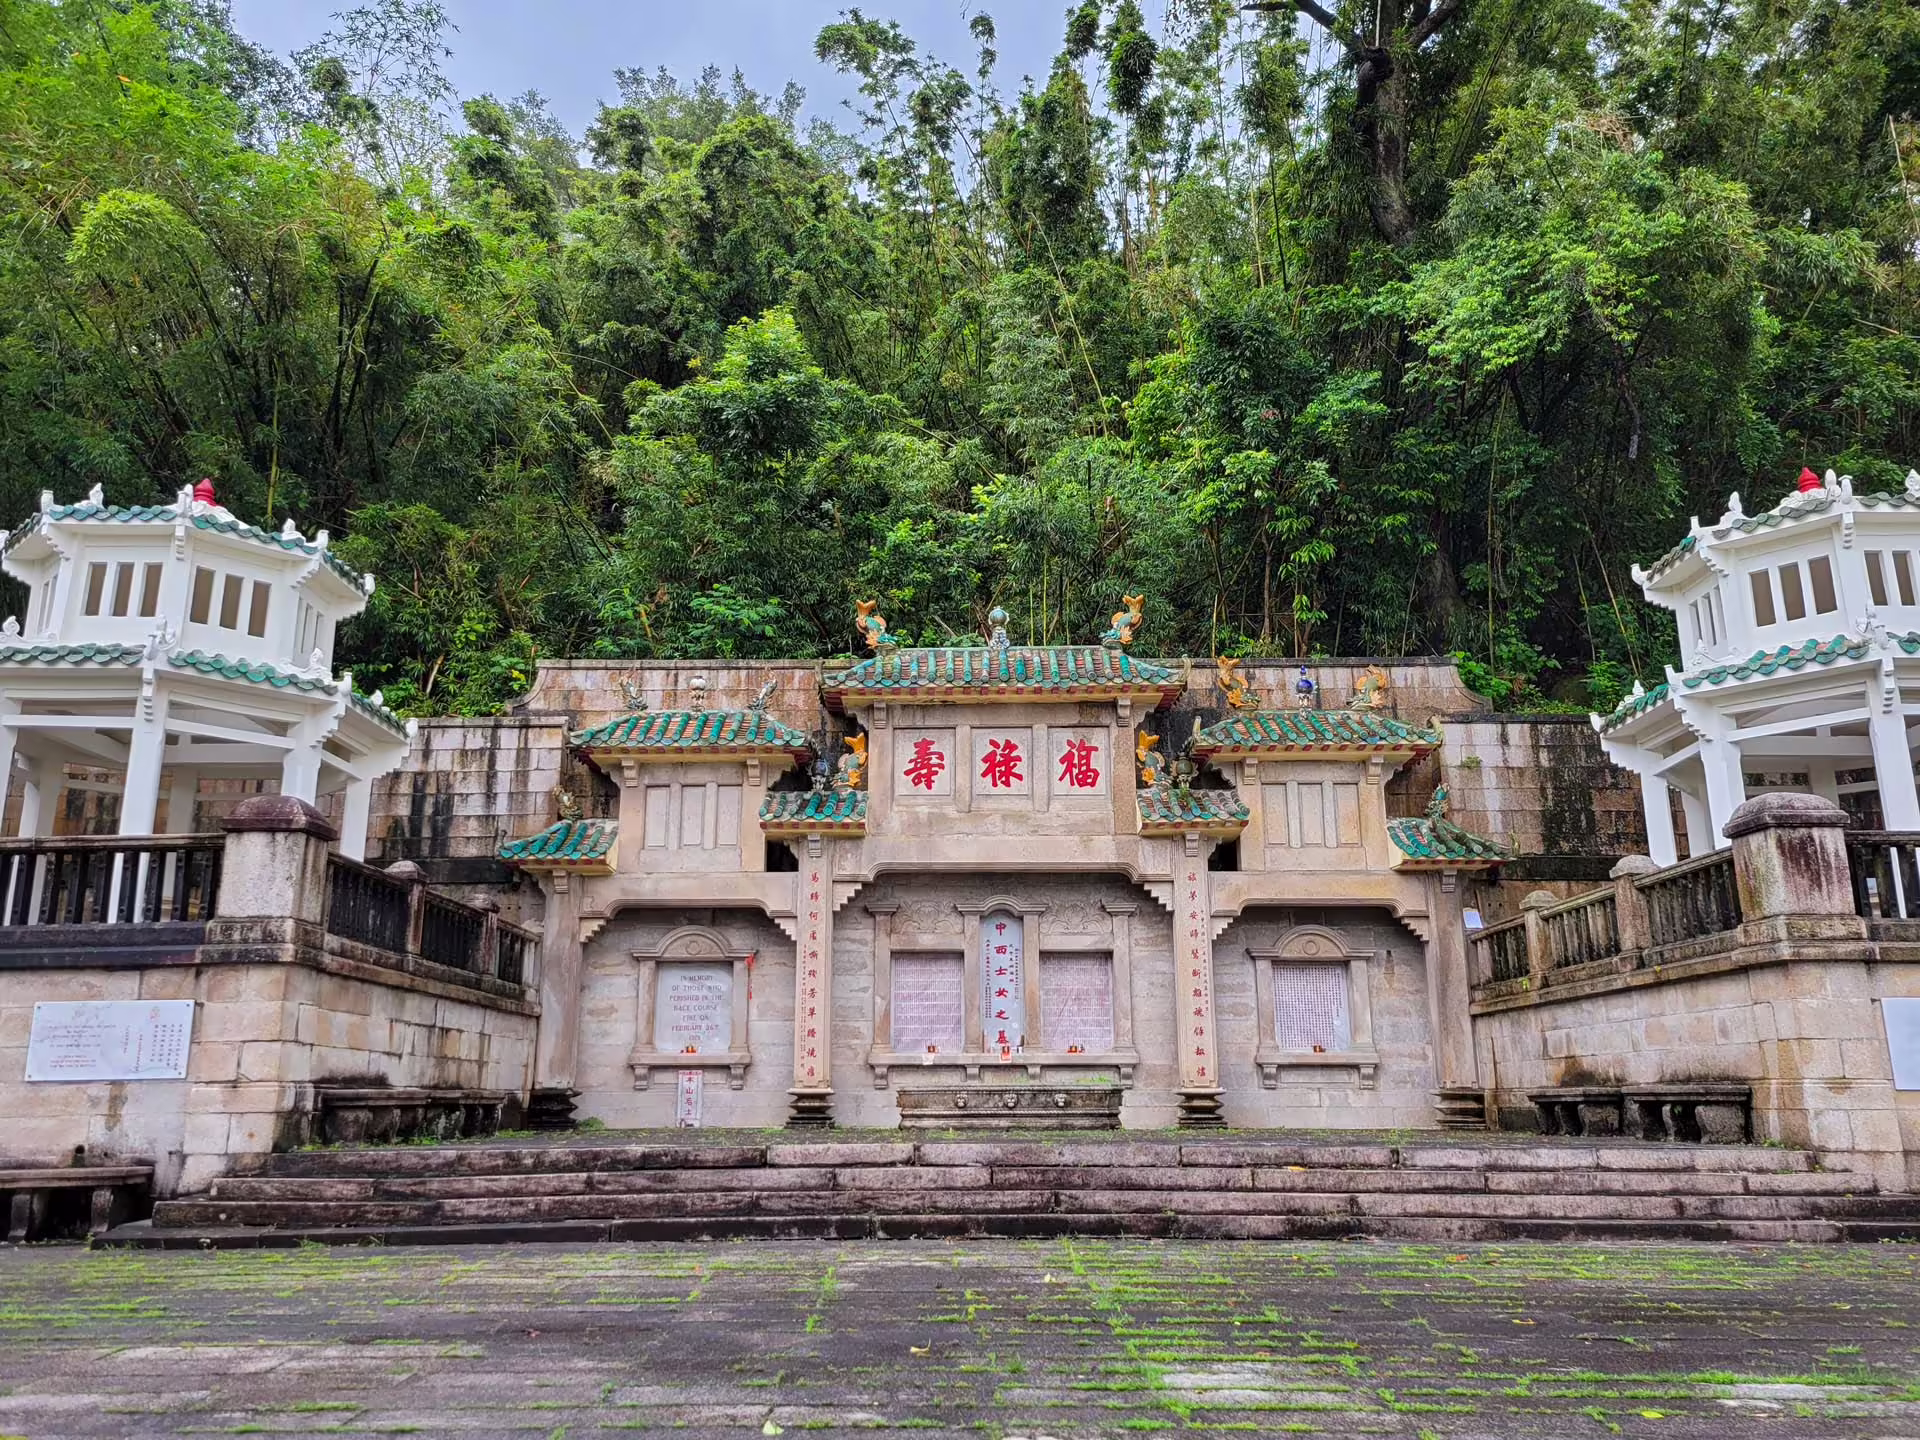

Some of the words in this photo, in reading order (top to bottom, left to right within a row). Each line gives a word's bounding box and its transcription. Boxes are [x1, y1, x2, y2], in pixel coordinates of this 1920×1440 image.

[903, 737, 945, 790] 壽
[980, 738, 1024, 787] 祿
[1058, 738, 1100, 788] 福
[671, 984, 680, 992] OF
[683, 984, 704, 992] THOSE
[669, 994, 700, 1002] PERISHED
[673, 1004, 690, 1012] RACE
[693, 1004, 718, 1012] COURSE
[682, 1014, 697, 1022] FIRE
[671, 1024, 702, 1032] FEBRUARY
